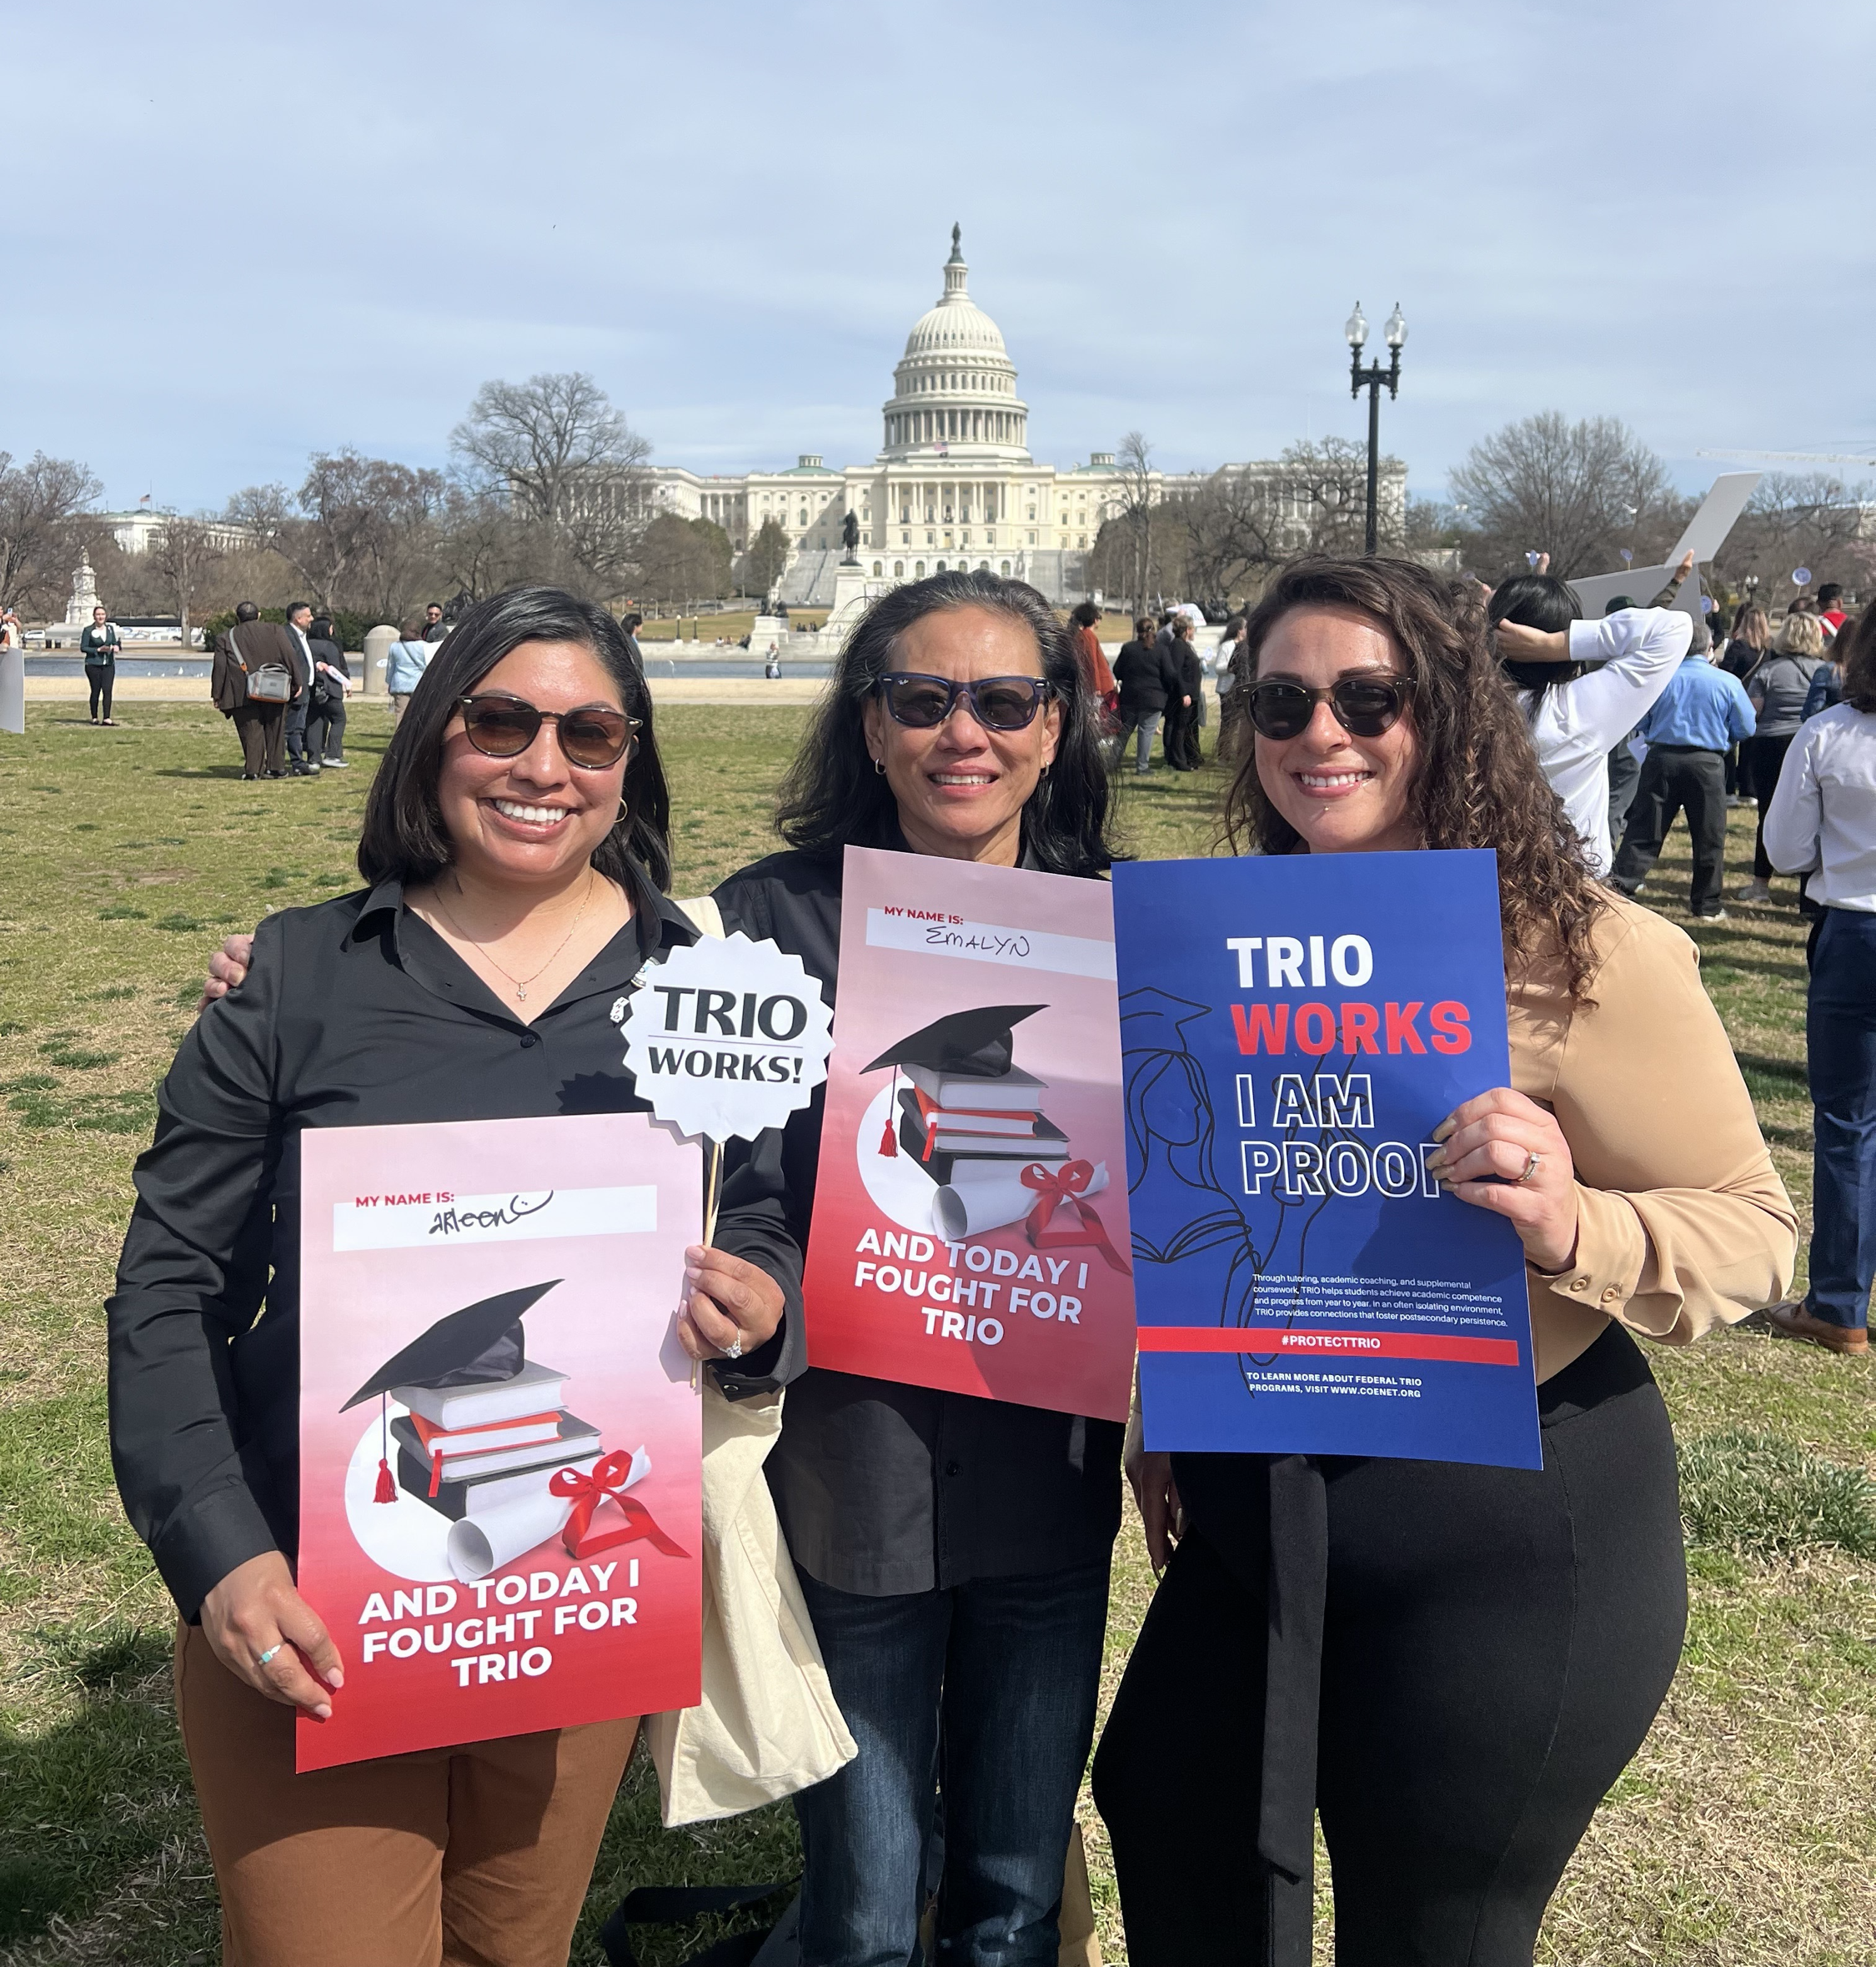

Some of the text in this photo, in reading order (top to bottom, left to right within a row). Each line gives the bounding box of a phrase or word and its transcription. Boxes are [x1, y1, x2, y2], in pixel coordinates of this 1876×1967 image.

[884, 906, 964, 925] MY NAME IS:
[1226, 934, 1374, 988] TRIO
[653, 985, 808, 1041] TRIO
[1230, 1001, 1472, 1056] WORKS
[648, 1046, 804, 1085] WORKS!
[1236, 1074, 1375, 1128] I AM
[356, 1192, 455, 1208] MY NAME IS:
[855, 1227, 1089, 1290] AND TODAY I
[854, 1260, 1083, 1325] FOUGHT FOR
[1252, 1274, 1472, 1289] Through tutoring, academic coaching, and supplemental
[1253, 1286, 1299, 1294] coursework,
[1322, 1287, 1343, 1297] helps
[1344, 1287, 1378, 1296] students
[1380, 1289, 1410, 1297] achieve
[1412, 1290, 1451, 1299] academic
[1452, 1293, 1502, 1303] competence
[921, 1306, 1005, 1347] TRIO
[1254, 1297, 1269, 1305] and
[1271, 1298, 1304, 1307] progress
[1305, 1297, 1323, 1306] from
[1324, 1300, 1342, 1308] year
[1352, 1300, 1372, 1309] year.
[1393, 1301, 1414, 1309] often
[1415, 1302, 1449, 1312] isolating
[1450, 1306, 1503, 1316] environment,
[1255, 1307, 1274, 1316] TRIO
[1276, 1308, 1309, 1317] provides
[1310, 1310, 1358, 1318] connections
[1376, 1312, 1398, 1320] foster
[1400, 1313, 1458, 1325] postsecondary
[1459, 1317, 1508, 1327] persistence.
[1282, 1335, 1381, 1349] #PROTECTTRIO
[1246, 1372, 1422, 1387] TO LEARN MORE ABOUT FEDERAL TRIO
[1250, 1383, 1421, 1397] PROGRAMS, VISIT WWW.COENET.ORG
[358, 1558, 640, 1625] AND TODAY I
[363, 1597, 639, 1663] FOUGHT FOR
[450, 1646, 553, 1688] TRIO
